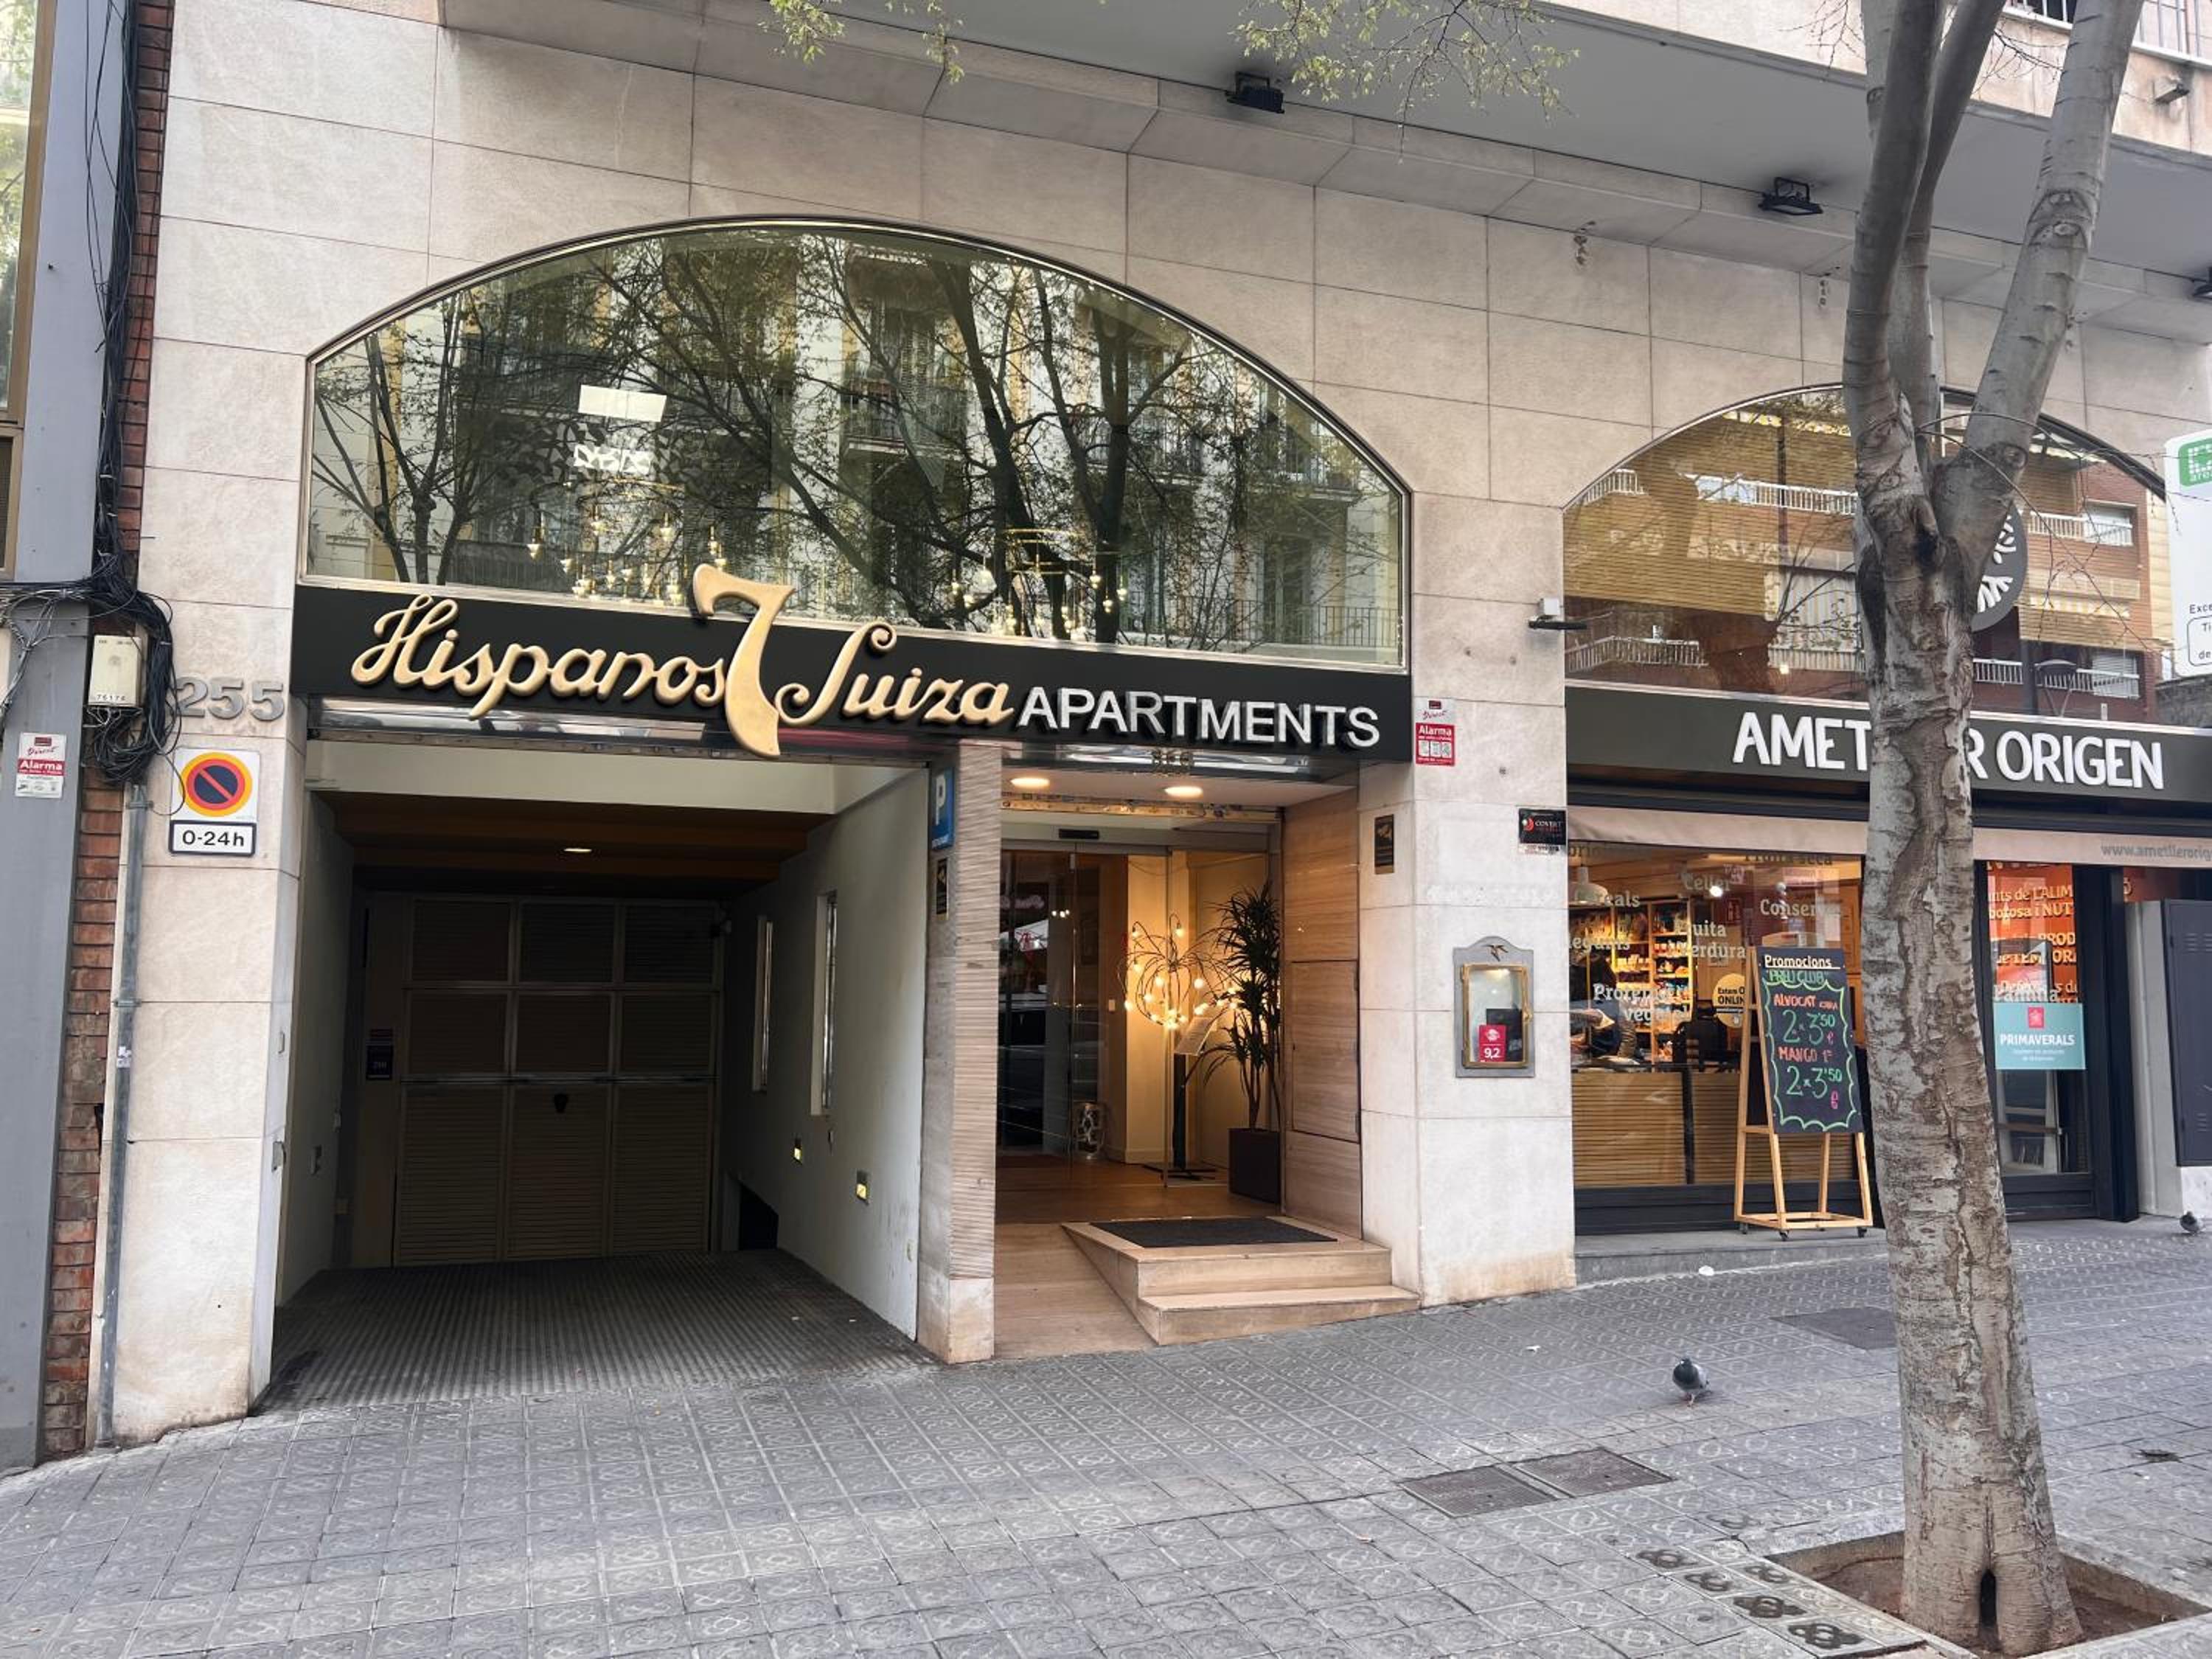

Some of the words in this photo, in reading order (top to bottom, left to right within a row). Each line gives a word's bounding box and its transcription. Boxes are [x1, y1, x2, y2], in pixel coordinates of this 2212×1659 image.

[351, 594, 726, 720] Hispanos
[776, 621, 1016, 726] Suiza
[1018, 686, 1380, 748] APARTMENTS
[175, 677, 285, 721] 255
[1419, 725, 1452, 737] Alarma
[1732, 712, 1989, 779] AMETR
[1996, 730, 2164, 790] ORIGEN
[20, 759, 63, 771] Alarma
[935, 774, 947, 826] P
[182, 830, 245, 846] 0-24h
[1688, 941, 1746, 958] erdura
[1764, 954, 1832, 968] Promocions
[1718, 995, 1745, 1005] ONLIN
[1773, 993, 1816, 1007] ALVOCAT
[2000, 1033, 2076, 1046] PRIMAVERALS
[1484, 1048, 1501, 1060] 9,2
[1778, 1046, 1818, 1062] MANGO
